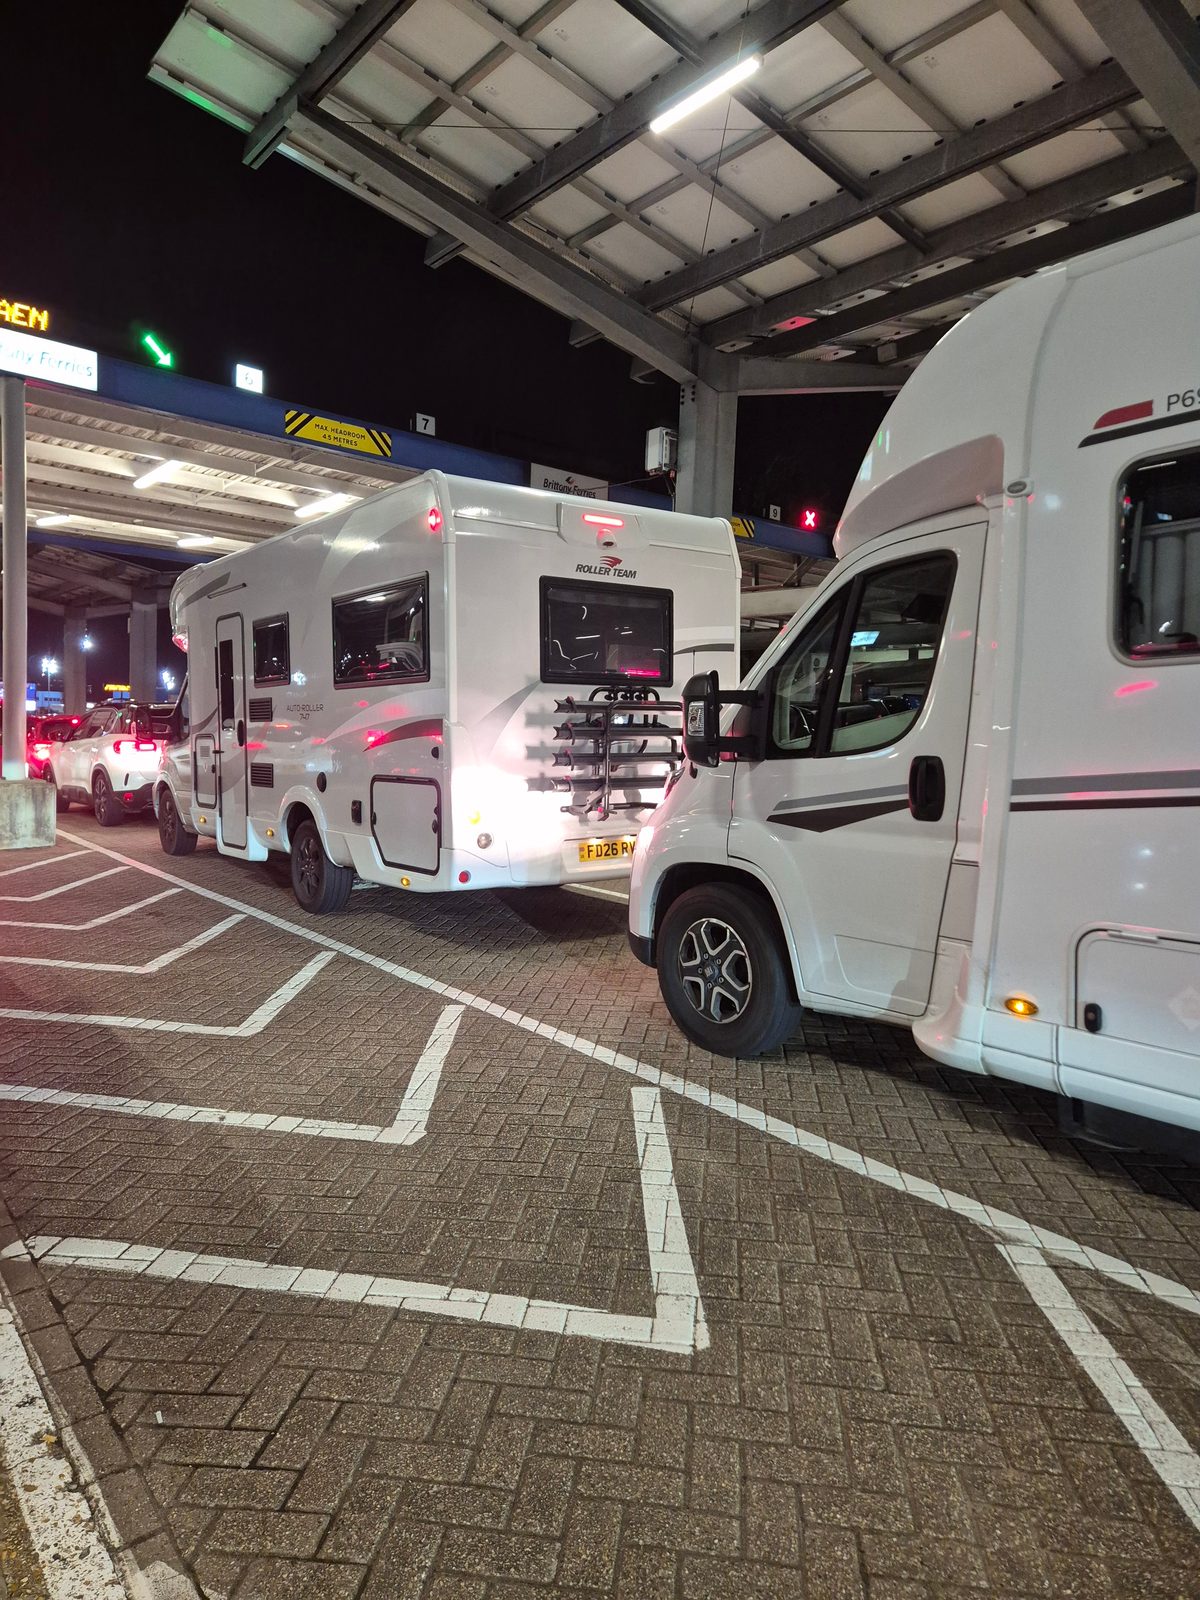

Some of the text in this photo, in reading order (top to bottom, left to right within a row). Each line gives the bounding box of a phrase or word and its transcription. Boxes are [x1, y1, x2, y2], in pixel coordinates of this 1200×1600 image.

[244, 371, 254, 386] 6
[422, 417, 429, 430] 7
[330, 427, 366, 440] HEADROOM
[333, 436, 358, 447] METRES
[543, 478, 597, 499] Brittany Ferries
[773, 508, 778, 518] 9
[575, 563, 637, 579] ROLLER TEAM
[587, 843, 619, 858] FD26
